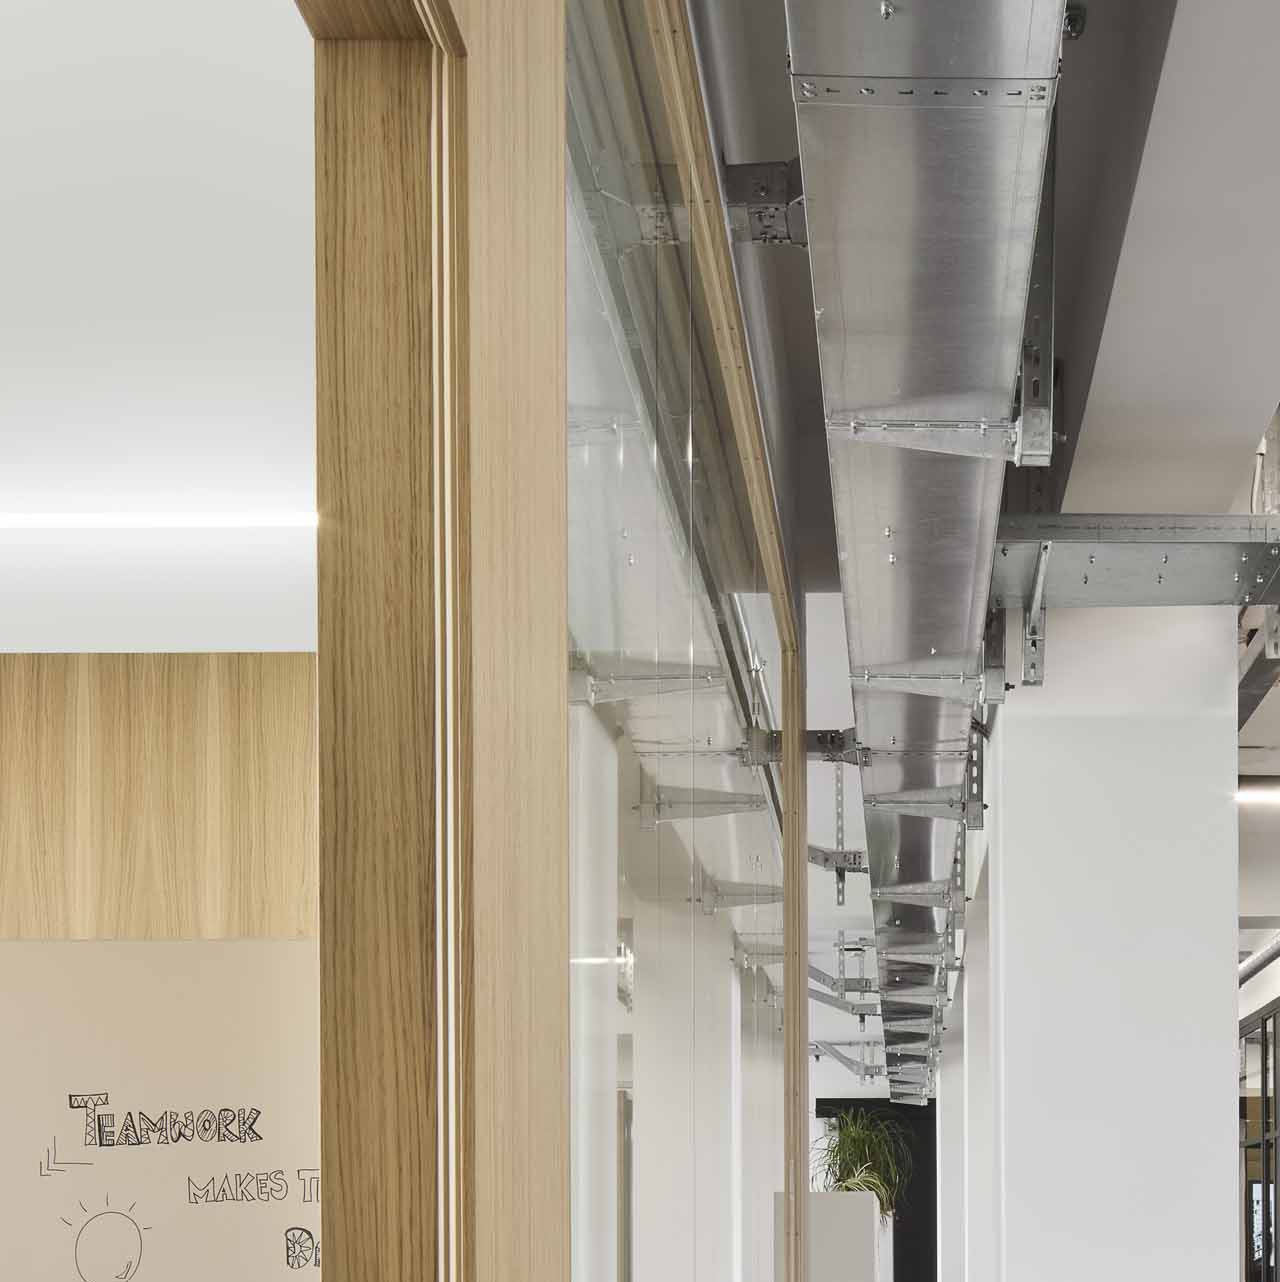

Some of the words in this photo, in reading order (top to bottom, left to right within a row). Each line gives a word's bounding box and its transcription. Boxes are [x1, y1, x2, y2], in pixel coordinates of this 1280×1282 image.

[68, 1093, 263, 1147] TEAMWORK
[187, 1169, 289, 1204] MAKES
[297, 1168, 320, 1203] T
[285, 1227, 320, 1269] D
